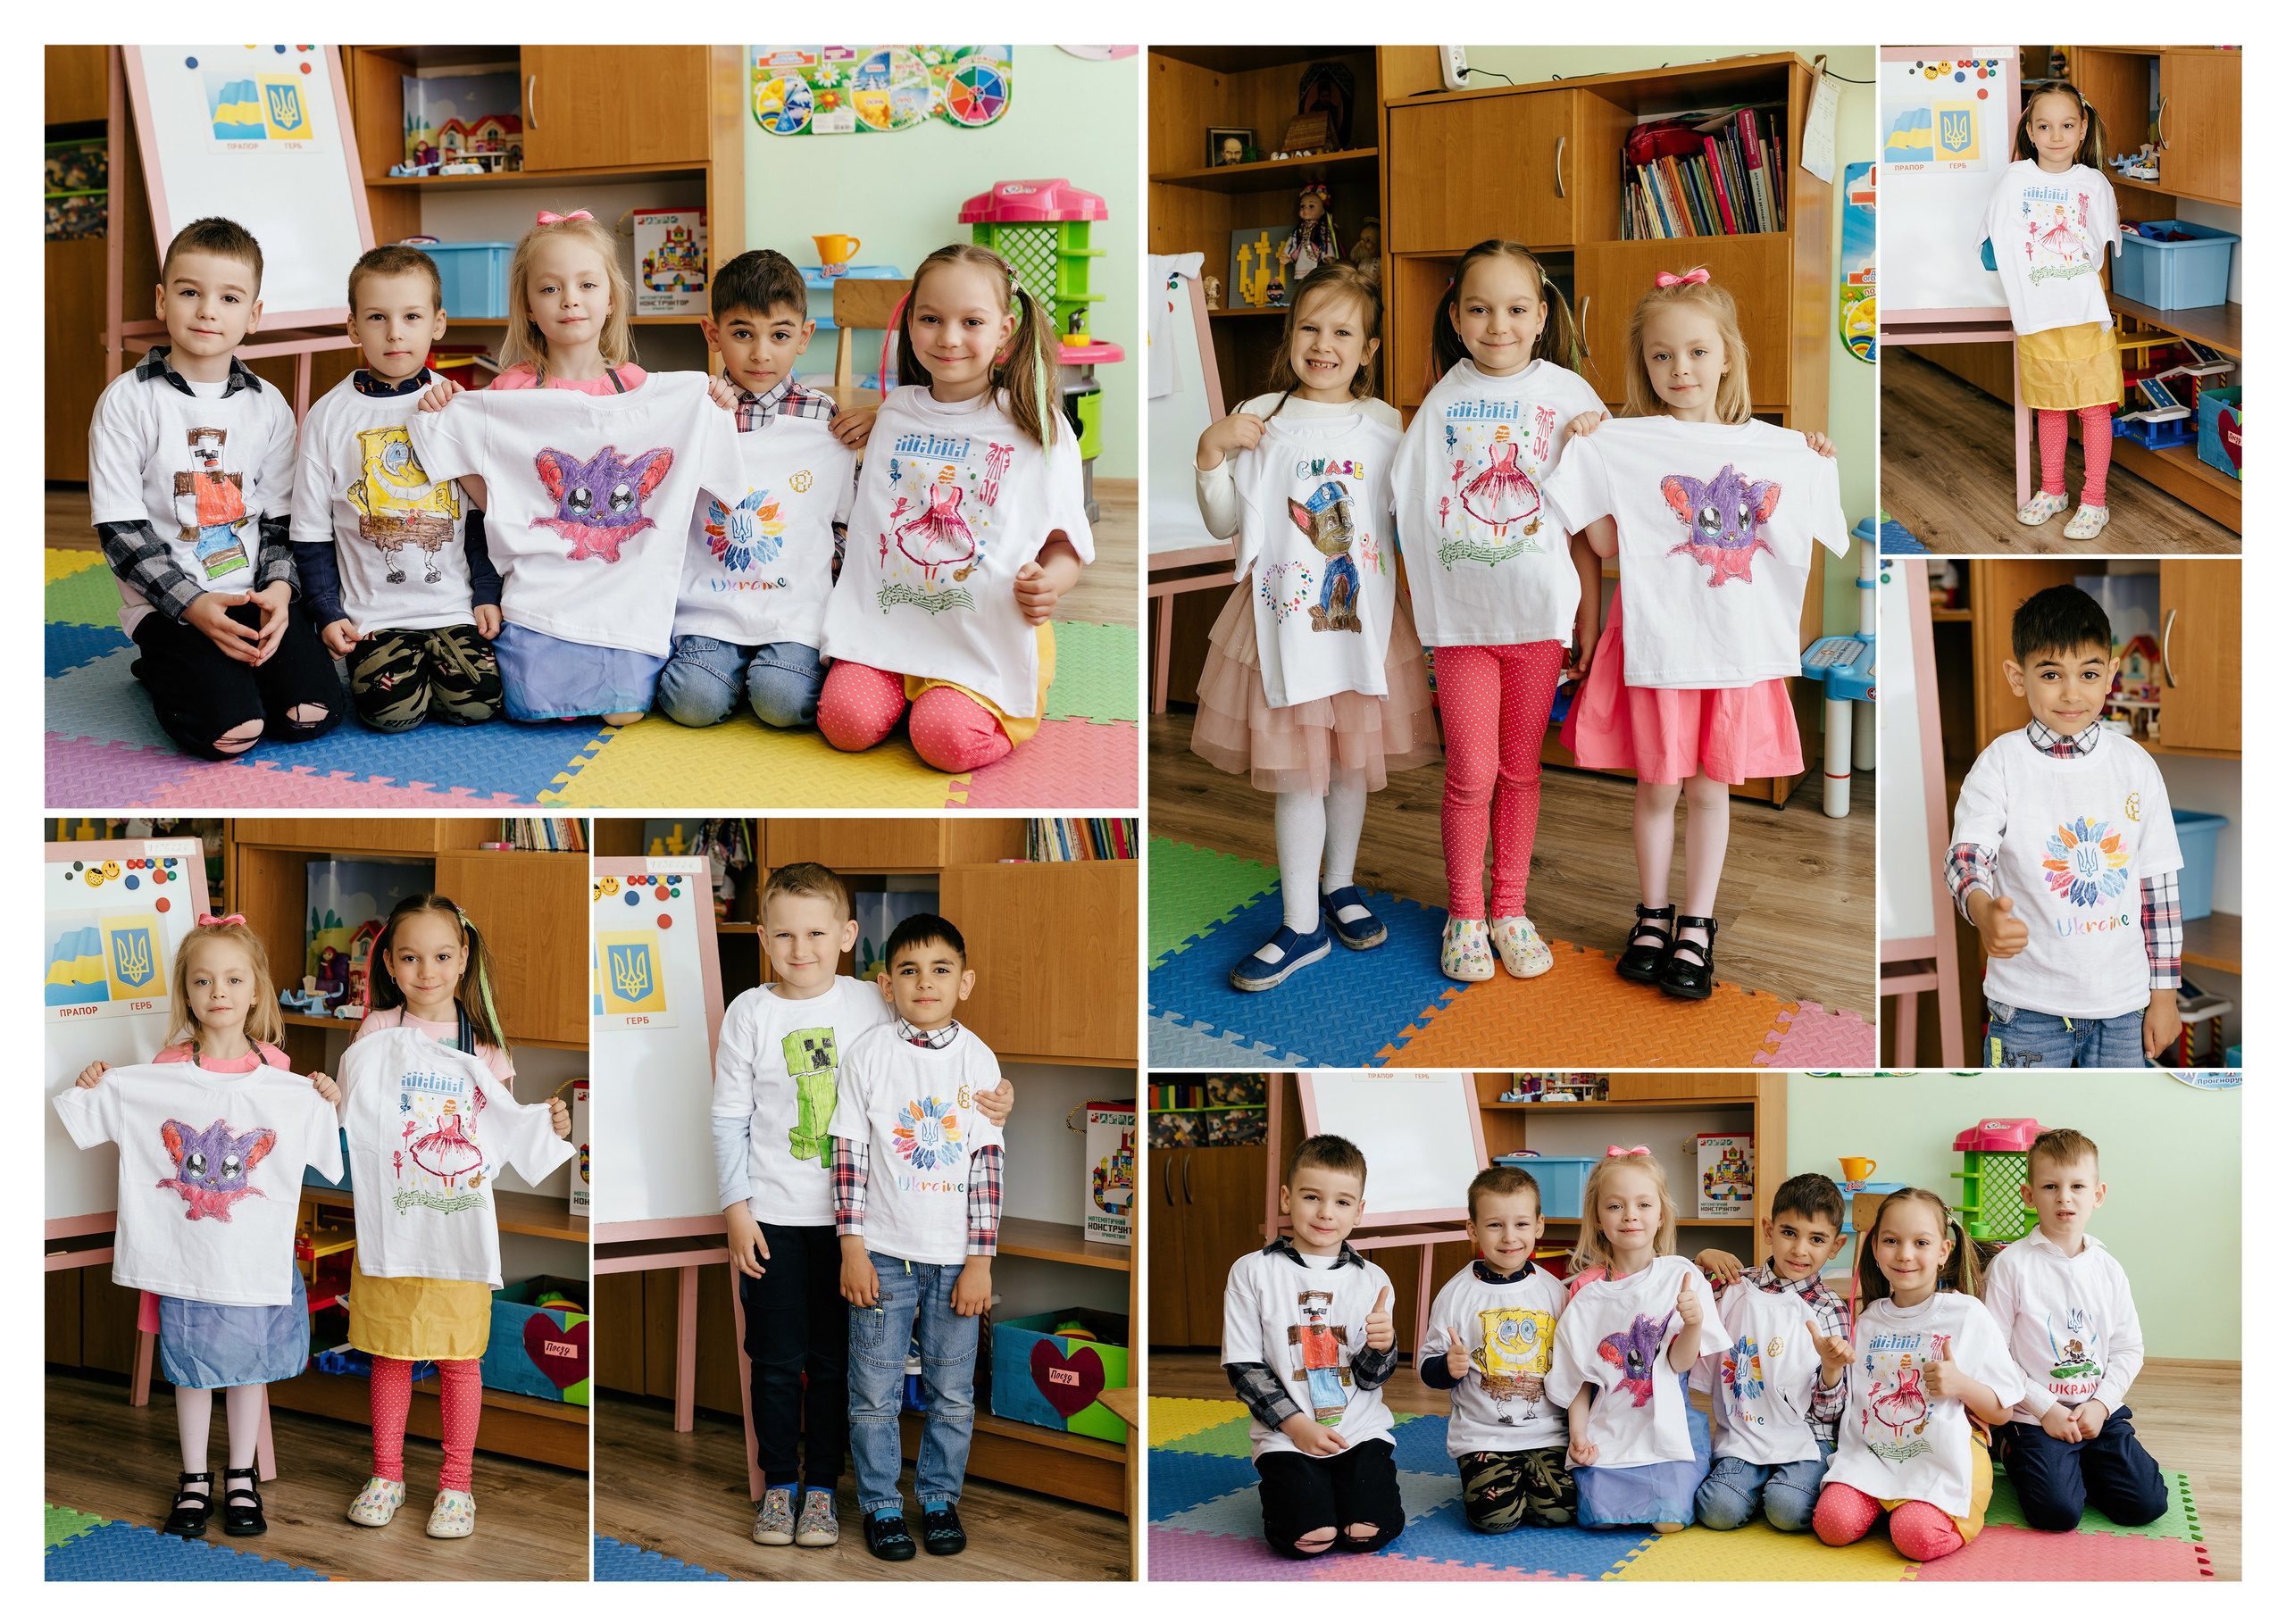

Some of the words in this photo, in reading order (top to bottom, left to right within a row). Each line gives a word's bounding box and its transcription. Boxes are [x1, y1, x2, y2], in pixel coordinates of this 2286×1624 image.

[1297, 458, 1364, 480] CHASE
[2057, 914, 2129, 937] Ukraine
[59, 1006, 98, 1017] ПРАПОР
[130, 1001, 152, 1011] ГЕРБ
[626, 1016, 649, 1025] ГЕРБ
[898, 1175, 964, 1193] Ukraine
[1088, 1216, 1126, 1226] МАТЕМАТИЧНИЙ
[546, 1343, 570, 1356] Посуд
[1051, 1370, 1072, 1384] Посуд
